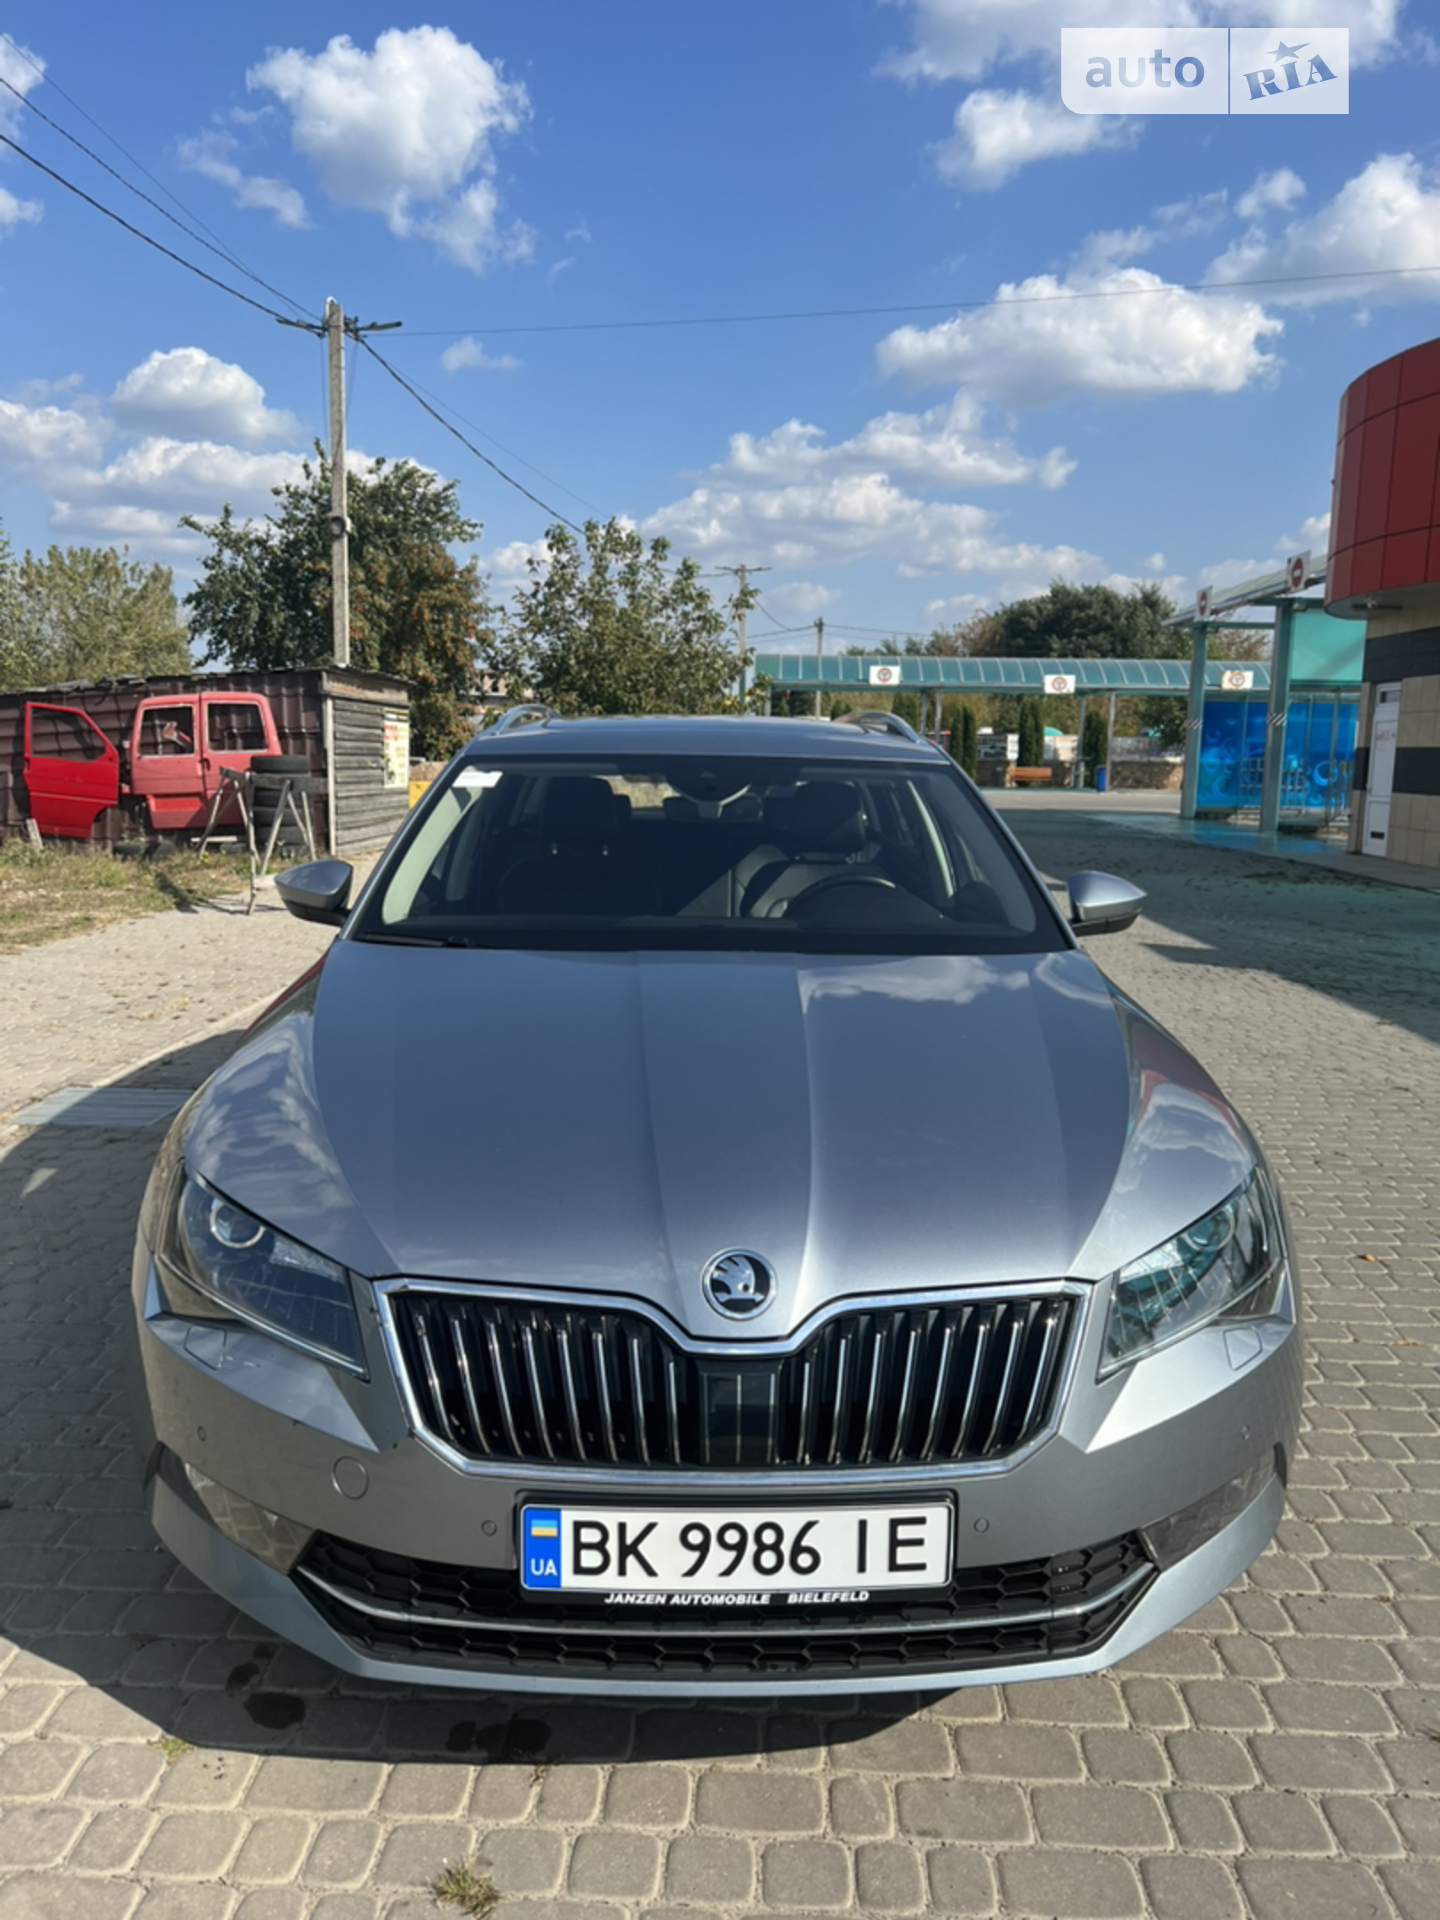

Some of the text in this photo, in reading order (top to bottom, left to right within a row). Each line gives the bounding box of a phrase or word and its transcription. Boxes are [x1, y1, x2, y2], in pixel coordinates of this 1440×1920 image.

[572, 1516, 928, 1577] BK 9986 IE
[530, 1559, 558, 1576] UA
[604, 1590, 870, 1606] JANZEN AUTOMOBILE BIELEFELD
